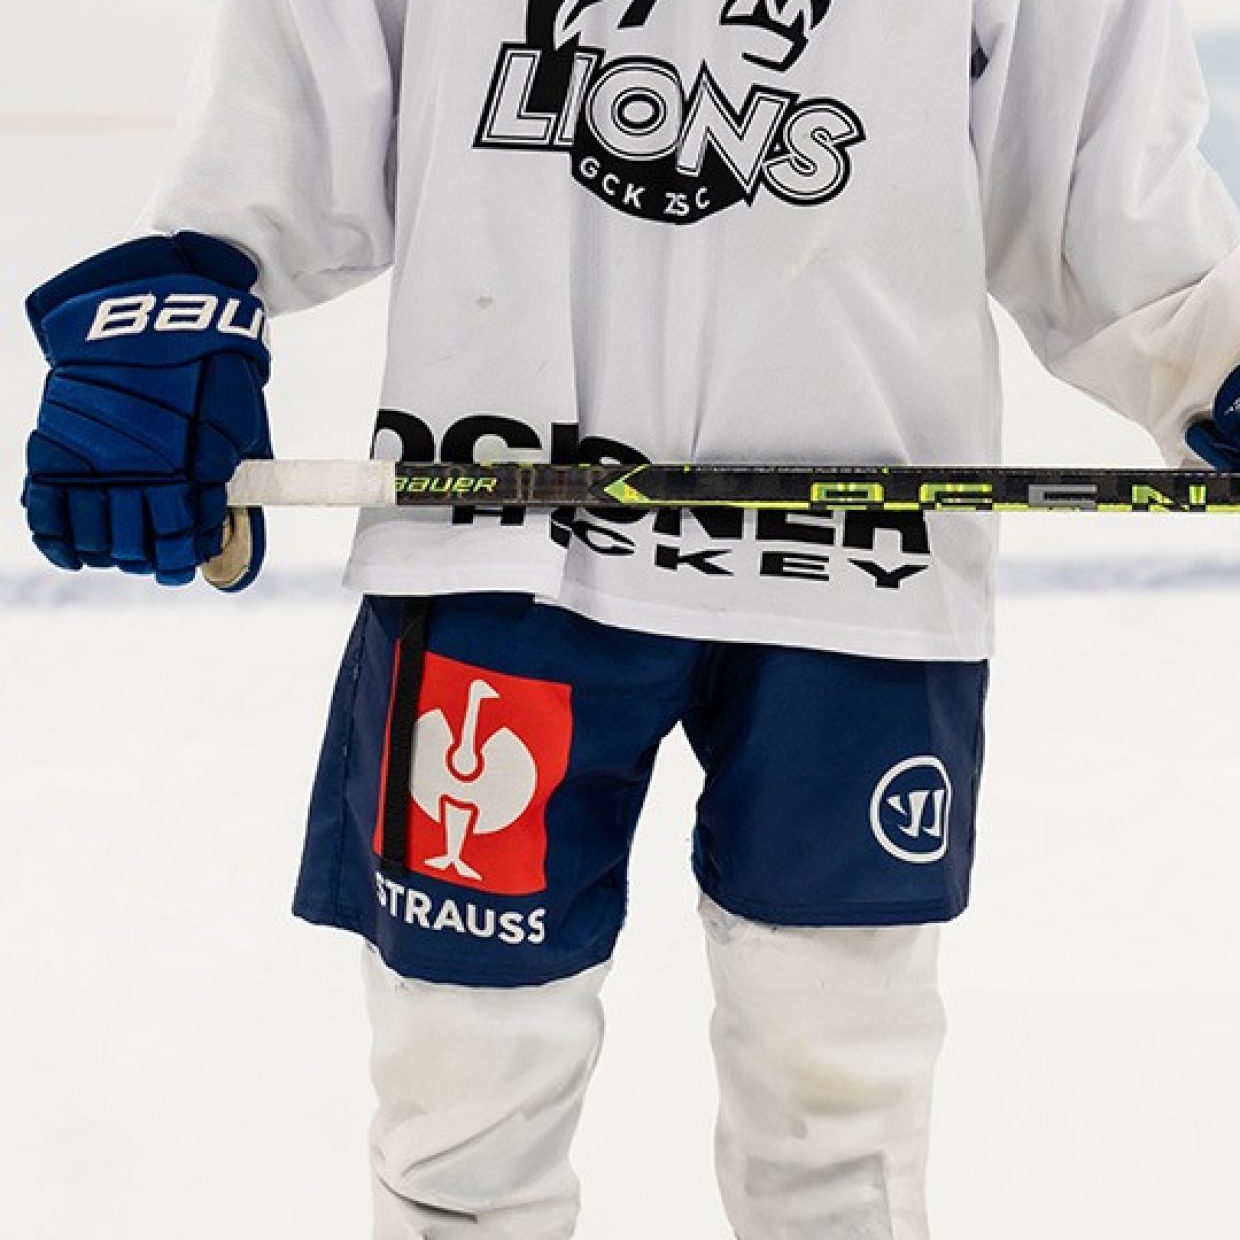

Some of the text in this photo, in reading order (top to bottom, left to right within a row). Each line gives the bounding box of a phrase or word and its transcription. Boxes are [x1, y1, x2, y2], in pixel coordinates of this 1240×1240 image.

[472, 41, 867, 207] LIONS
[577, 155, 711, 217] GCK ZSC
